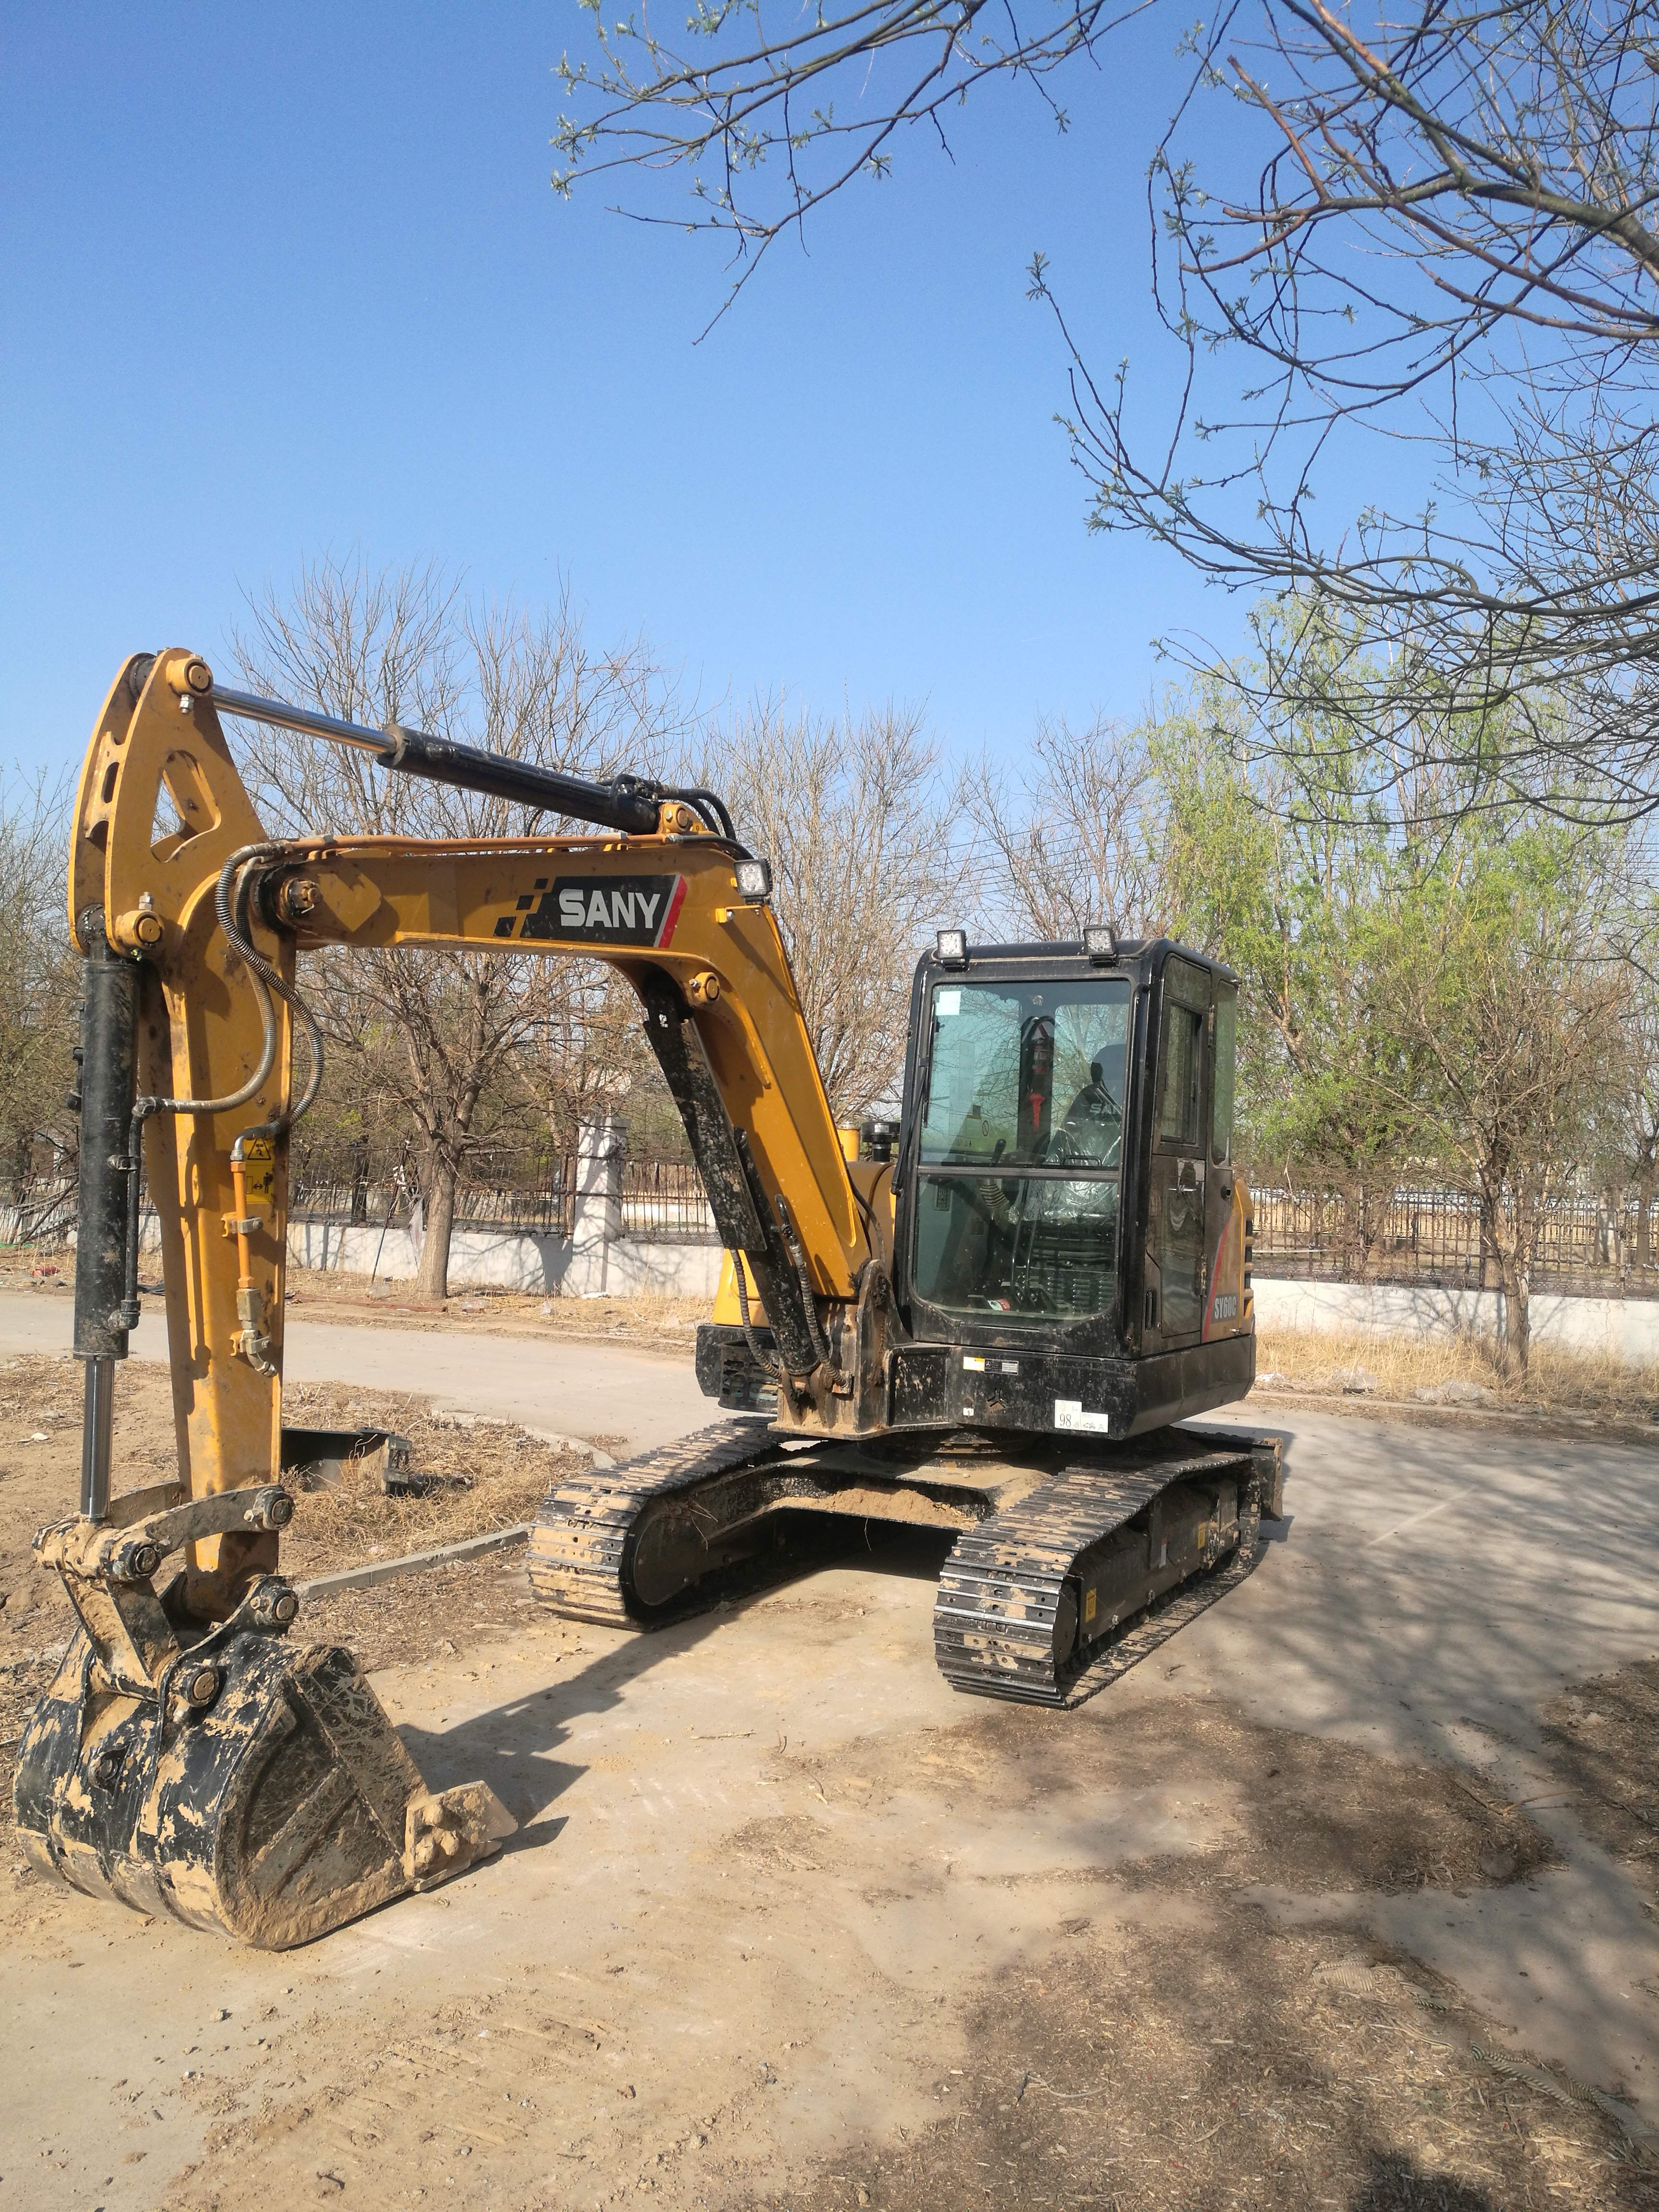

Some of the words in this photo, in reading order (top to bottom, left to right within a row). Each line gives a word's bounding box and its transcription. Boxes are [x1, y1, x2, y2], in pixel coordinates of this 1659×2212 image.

[559, 889, 661, 928] SANY
[1214, 1296, 1237, 1319] SY60C
[1060, 1413, 1071, 1427] 98
